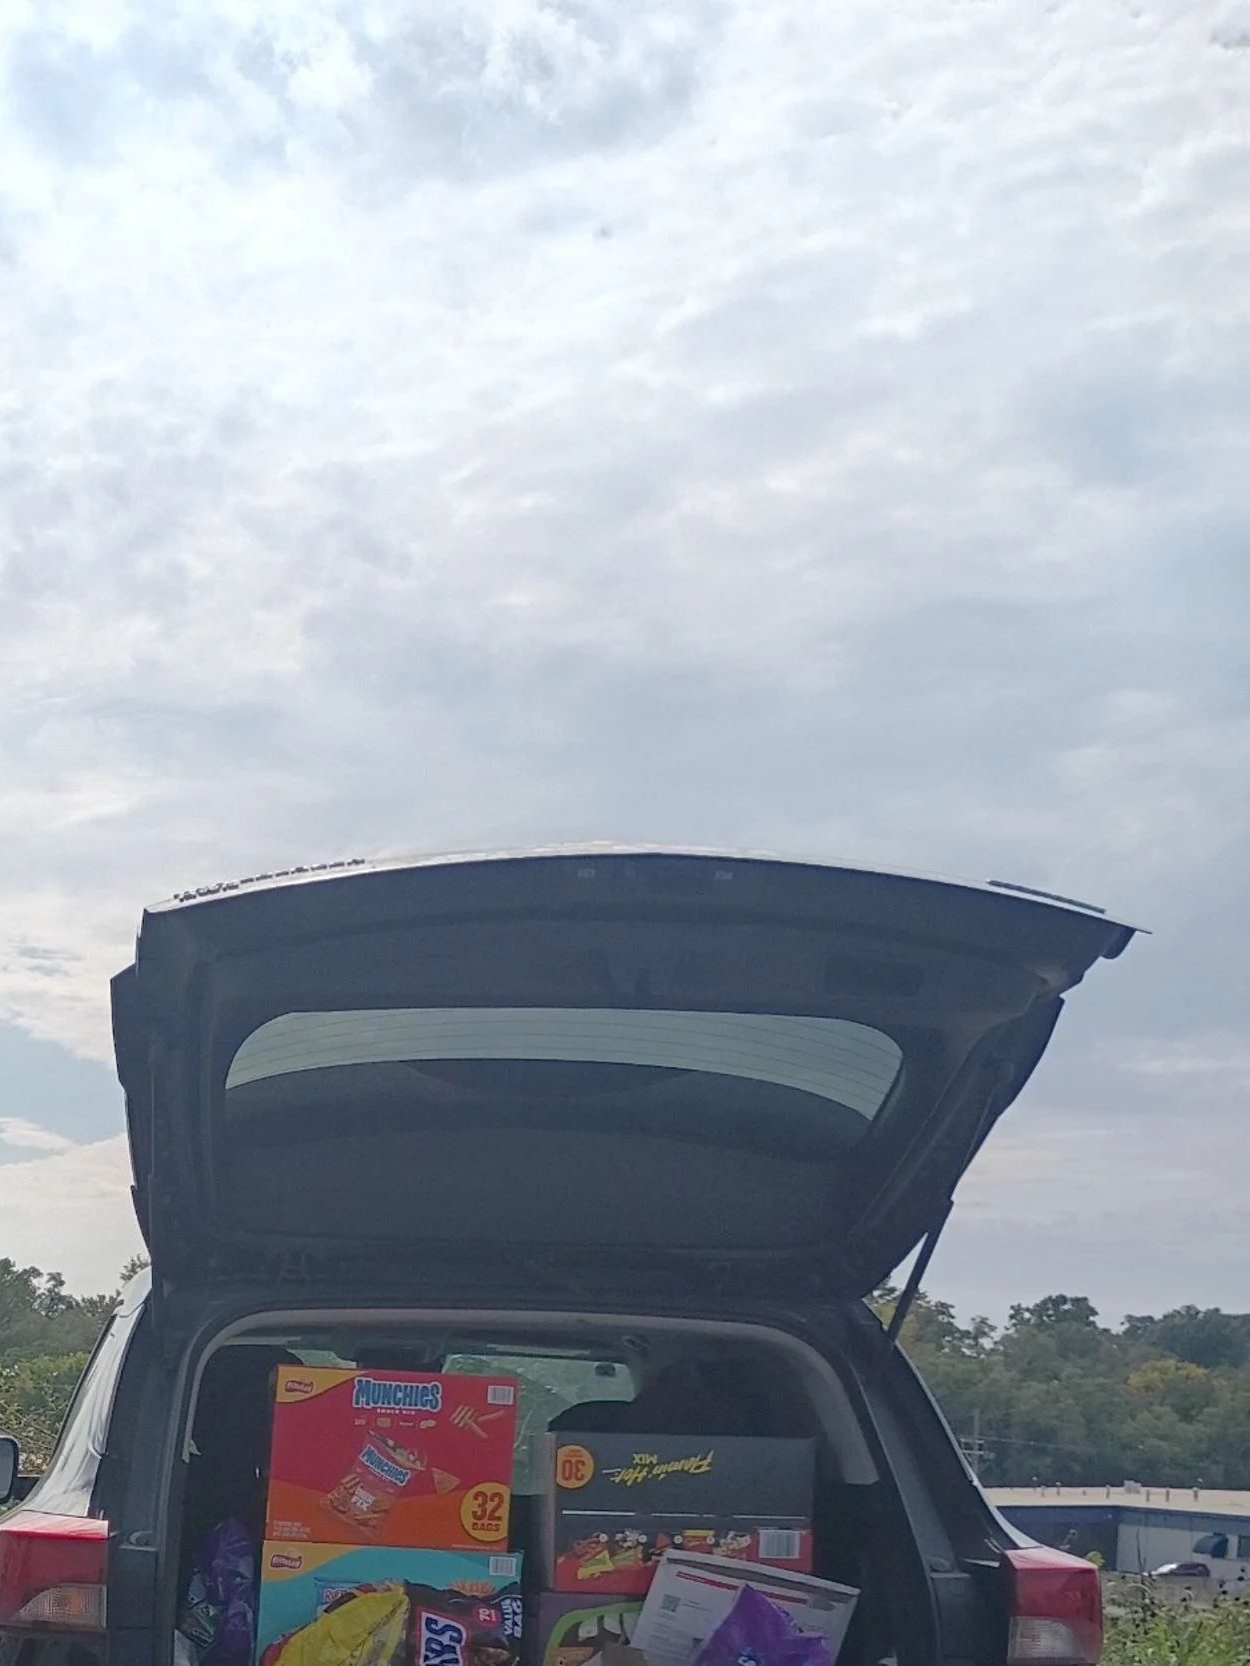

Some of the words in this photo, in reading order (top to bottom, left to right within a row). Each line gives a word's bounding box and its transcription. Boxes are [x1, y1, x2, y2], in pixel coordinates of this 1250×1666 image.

[632, 1453, 658, 1465] MIX
[561, 1459, 586, 1481] 30
[471, 1490, 504, 1521] 32
[471, 1521, 500, 1533] BAGS
